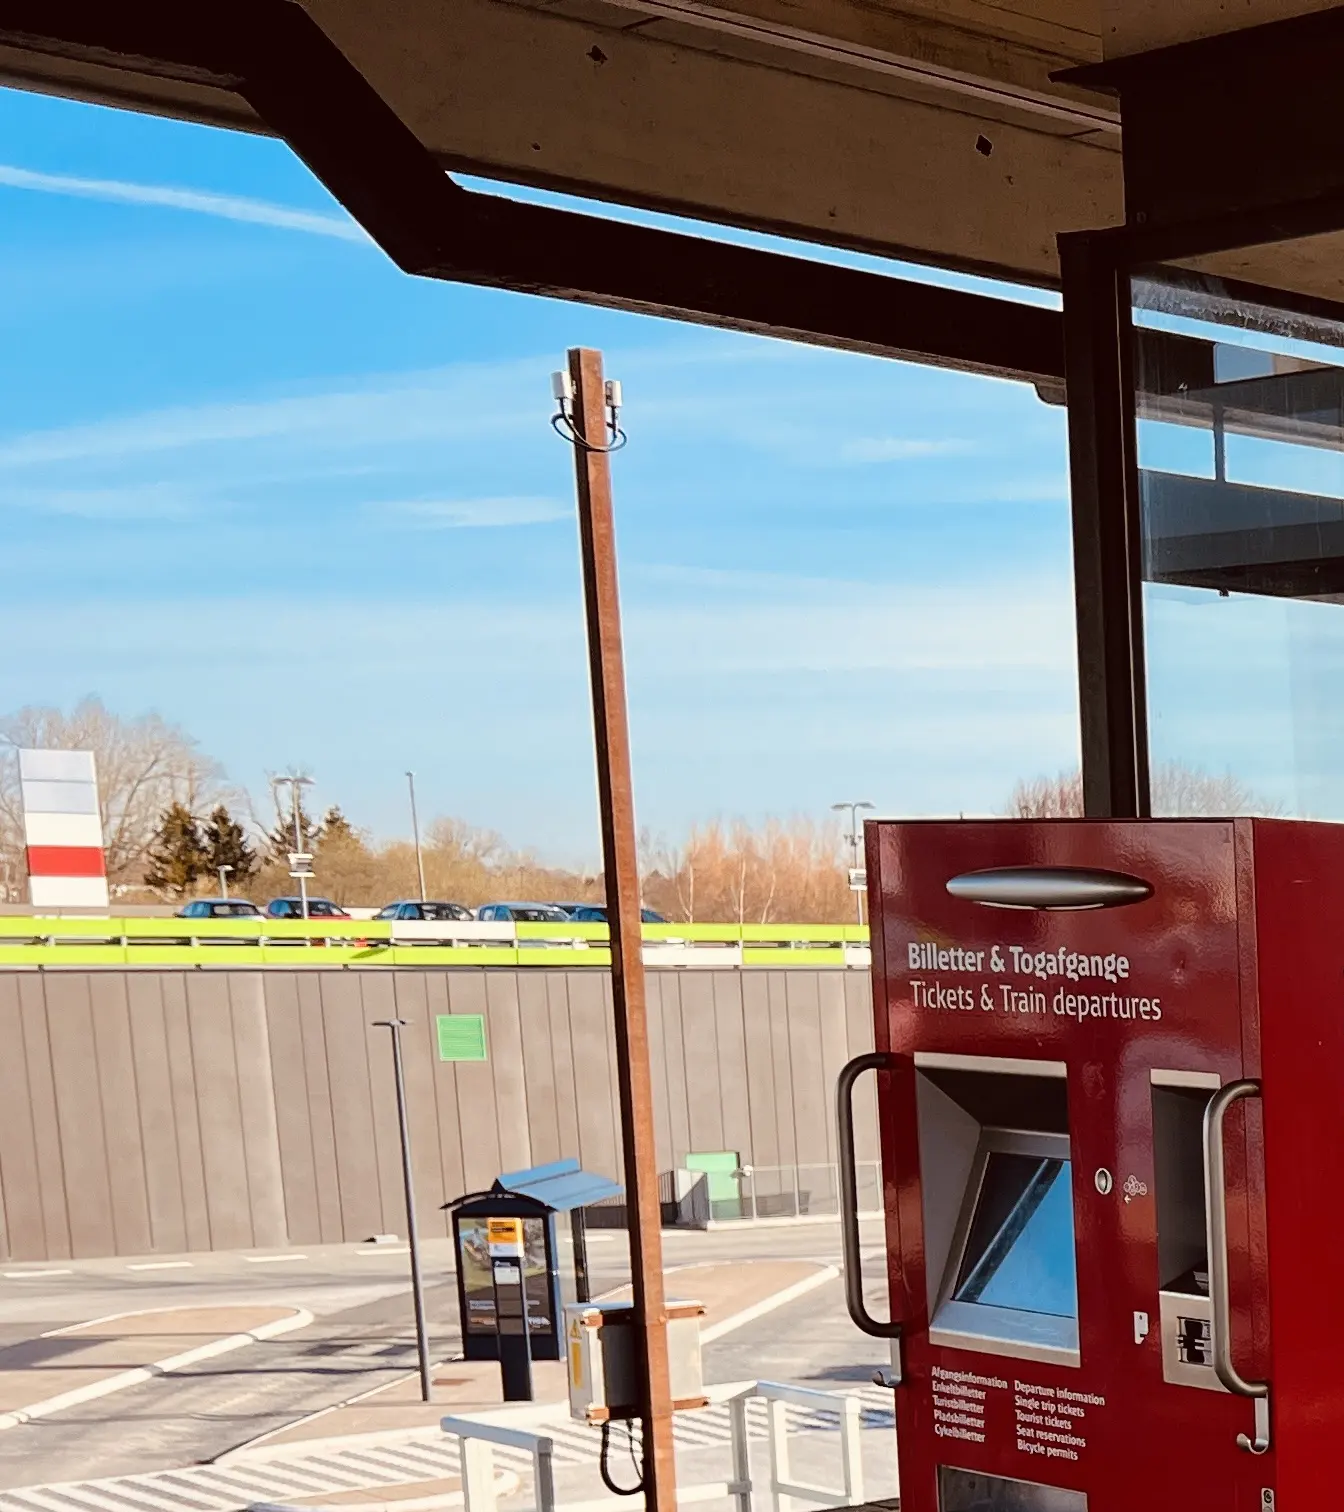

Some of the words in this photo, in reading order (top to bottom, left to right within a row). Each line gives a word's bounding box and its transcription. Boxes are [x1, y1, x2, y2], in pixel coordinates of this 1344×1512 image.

[908, 942, 985, 972] Billetter
[990, 945, 1006, 973] &
[1009, 946, 1130, 984] Togafgange
[909, 980, 975, 1011] Tickets
[980, 983, 995, 1012] &
[999, 984, 1047, 1014] Train
[1053, 986, 1162, 1023] departures
[931, 1365, 1008, 1390] Afgangsinformation
[932, 1380, 987, 1400] Enkeltbilletter
[1013, 1379, 1055, 1398] Departure
[1056, 1386, 1106, 1406] information
[932, 1394, 985, 1415] Turistbilletter
[1014, 1395, 1040, 1411] Single
[1041, 1400, 1056, 1414] trip
[1057, 1401, 1085, 1418] tickets
[933, 1409, 986, 1429] Pladsbilletter
[1015, 1409, 1044, 1426] Tourist
[1045, 1414, 1072, 1430] tickets
[934, 1423, 986, 1443] Cykelbilletter
[1016, 1424, 1035, 1439] Seat
[1036, 1430, 1086, 1448] reservations
[1017, 1438, 1045, 1455] Bicycle
[1046, 1446, 1079, 1461] permits
